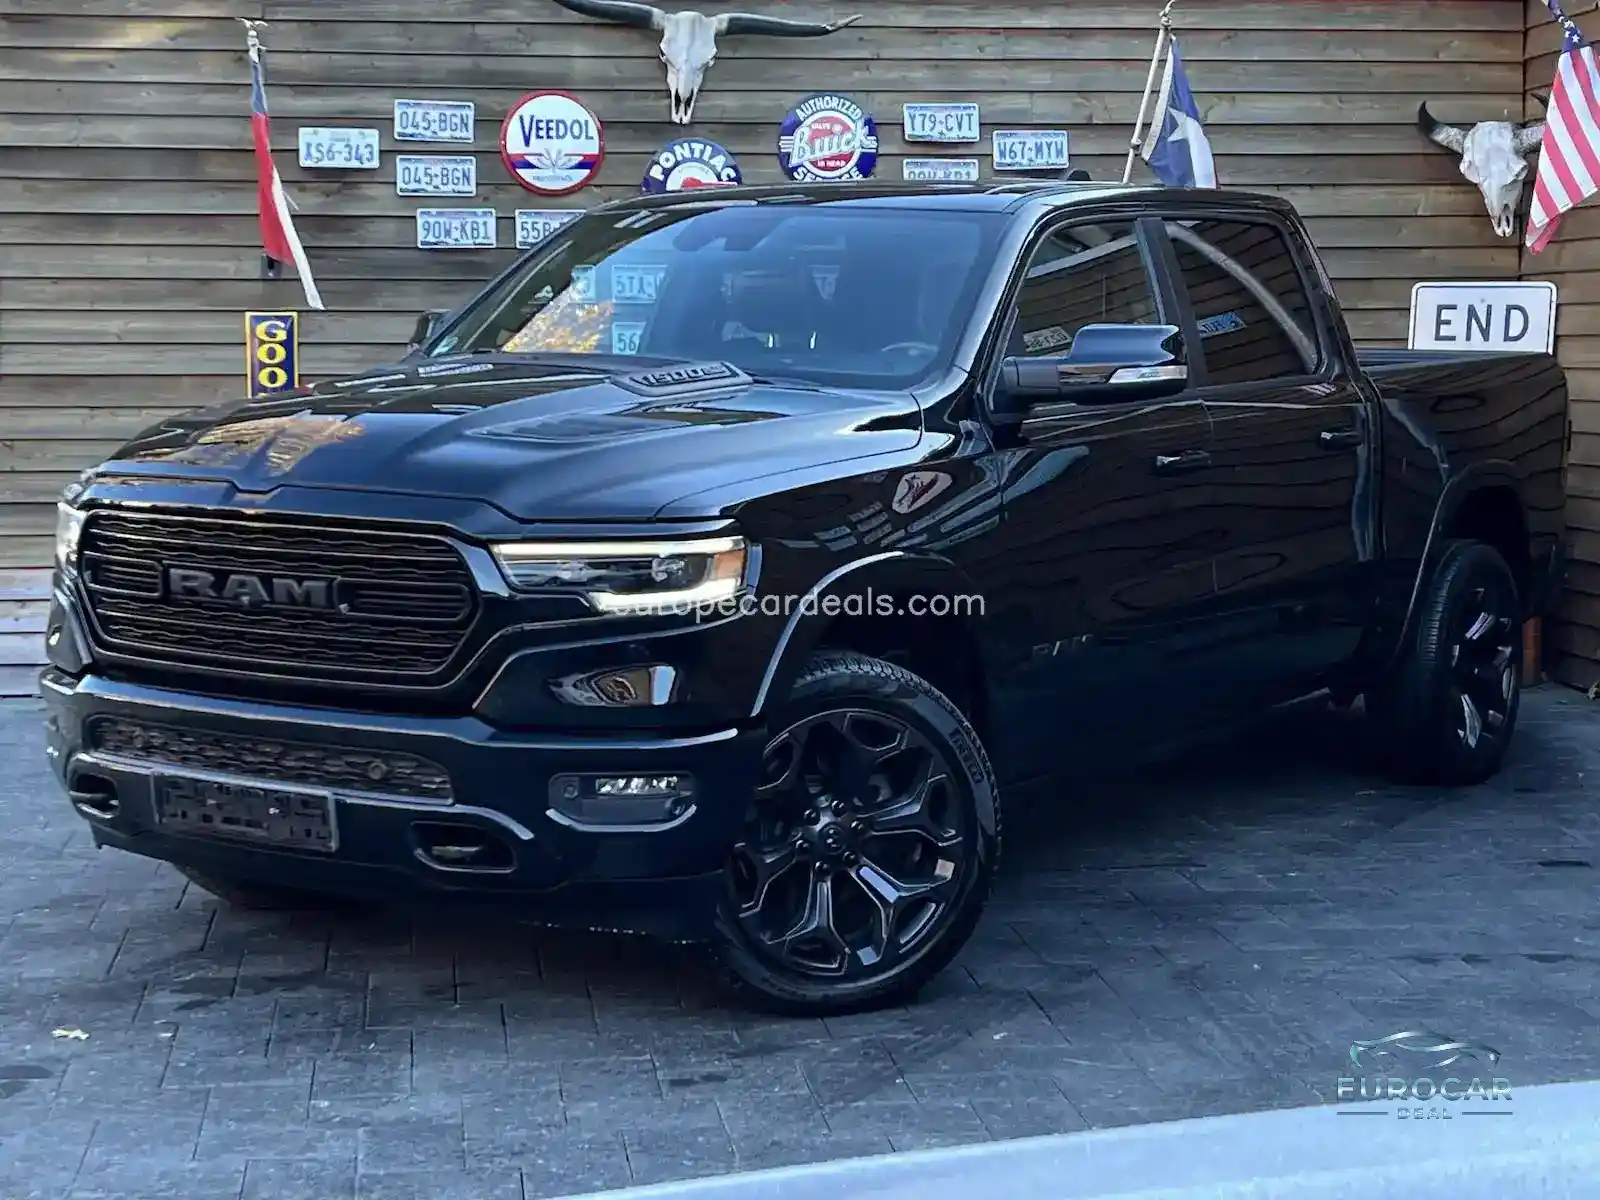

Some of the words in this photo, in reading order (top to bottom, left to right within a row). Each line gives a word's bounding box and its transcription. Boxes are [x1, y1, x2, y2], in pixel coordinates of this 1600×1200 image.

[796, 95, 862, 121] AUTHORIZED
[519, 114, 594, 147] VEEDOL
[788, 119, 878, 168] Buick
[649, 142, 737, 182] PONTIAC
[1434, 304, 1530, 342] END
[256, 320, 288, 397] GOO
[169, 568, 330, 607] RAM
